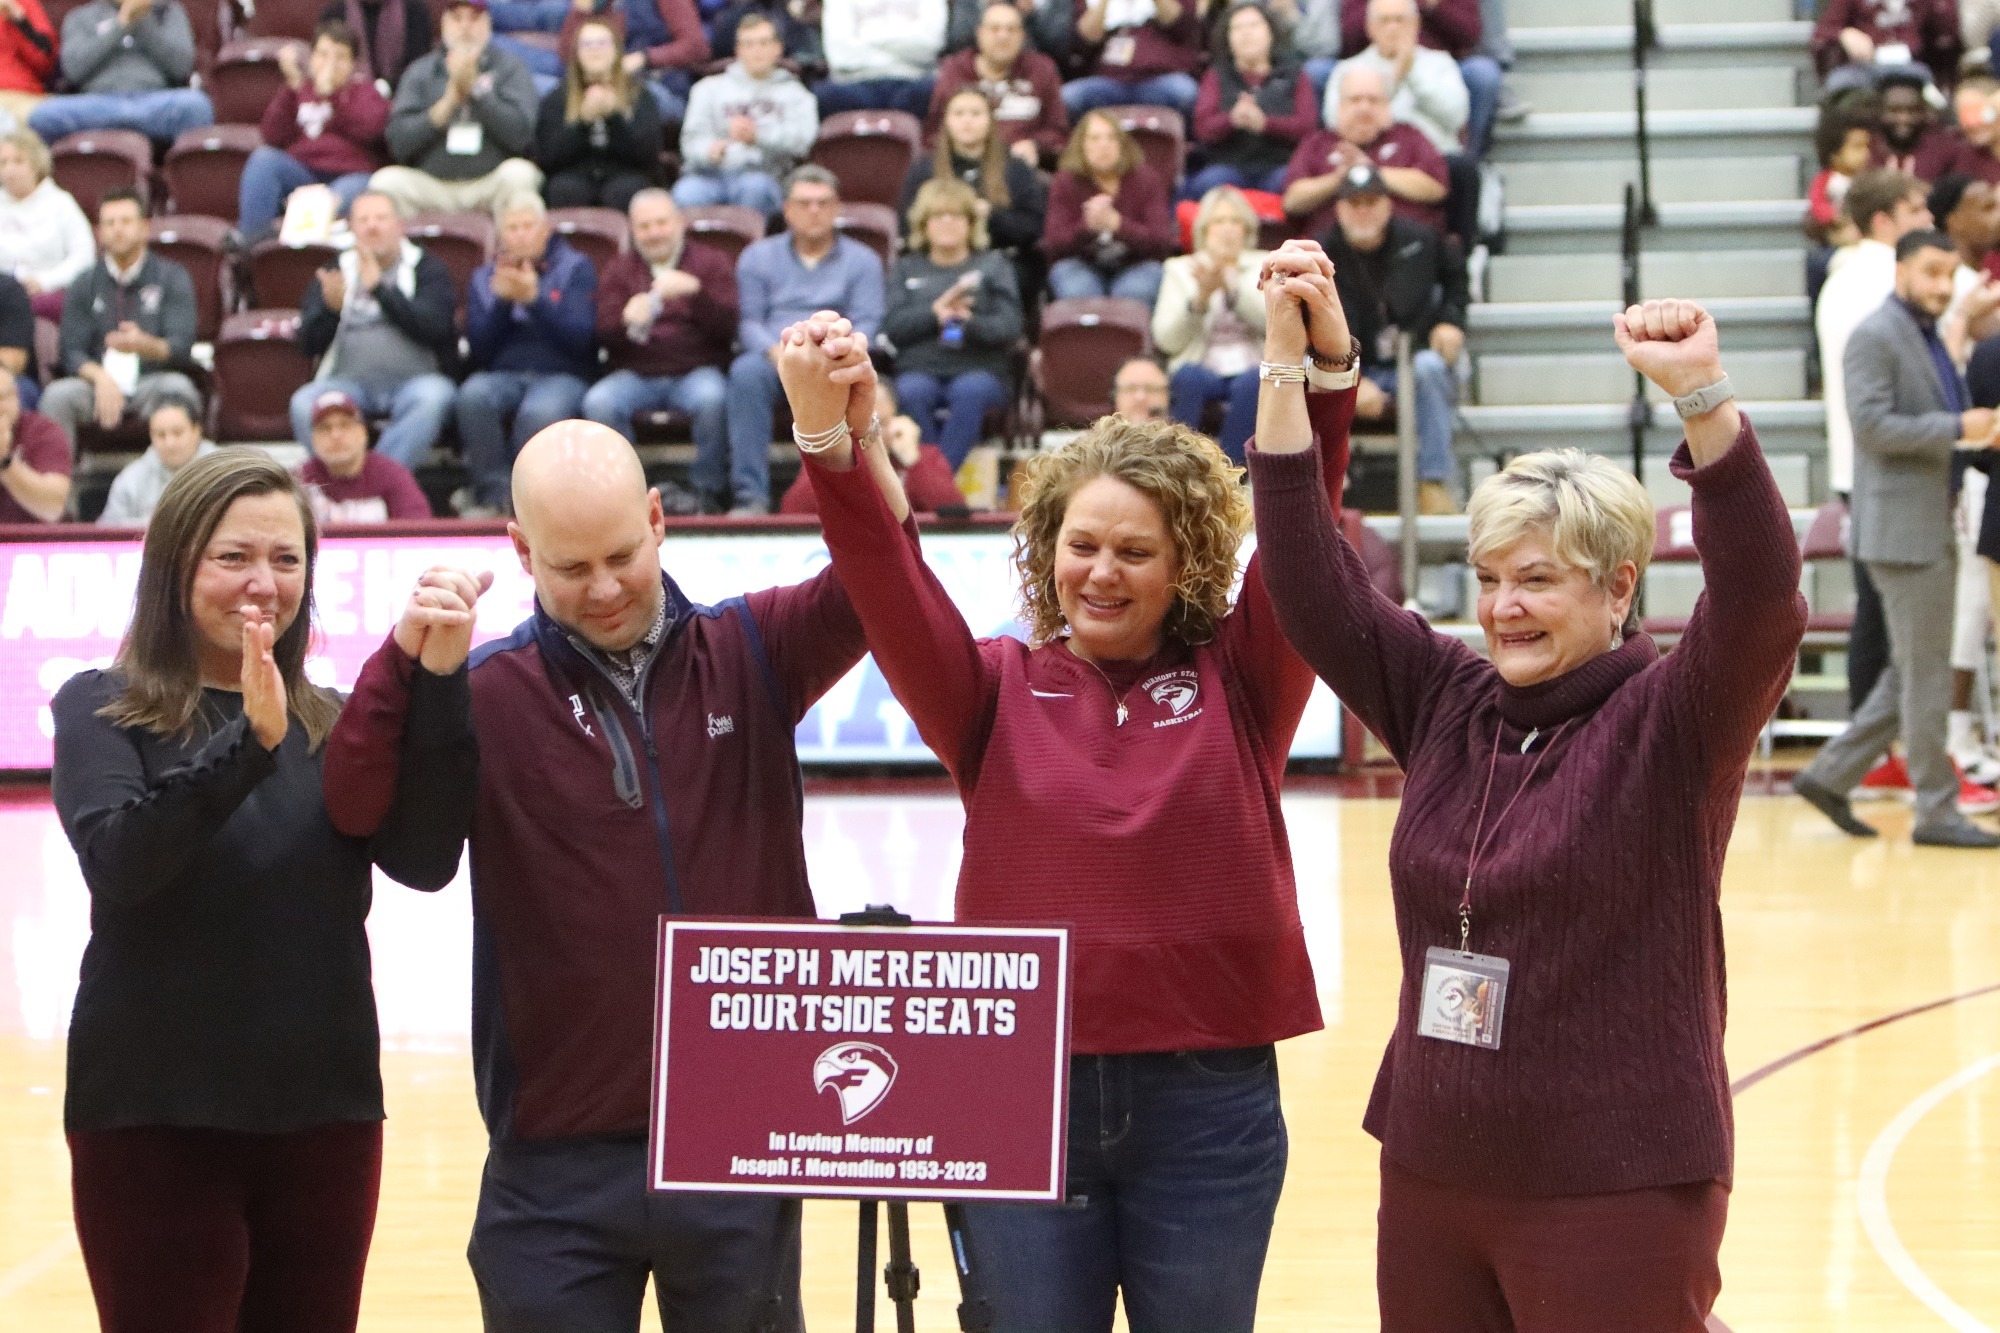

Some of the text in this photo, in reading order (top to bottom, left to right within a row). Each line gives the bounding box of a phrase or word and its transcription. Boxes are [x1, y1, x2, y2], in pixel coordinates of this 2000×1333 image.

[1142, 672, 1177, 690] FAIRMONT
[569, 694, 595, 737] RLX
[1153, 708, 1203, 728] BASKETBAL
[691, 947, 1039, 990] JOSEPH MERENDINO
[710, 993, 1016, 1035] COURTSIDE SEATS
[768, 1131, 934, 1156] In Loving Memory of
[729, 1155, 987, 1182] Joseph F. Merendino 1953-2023
